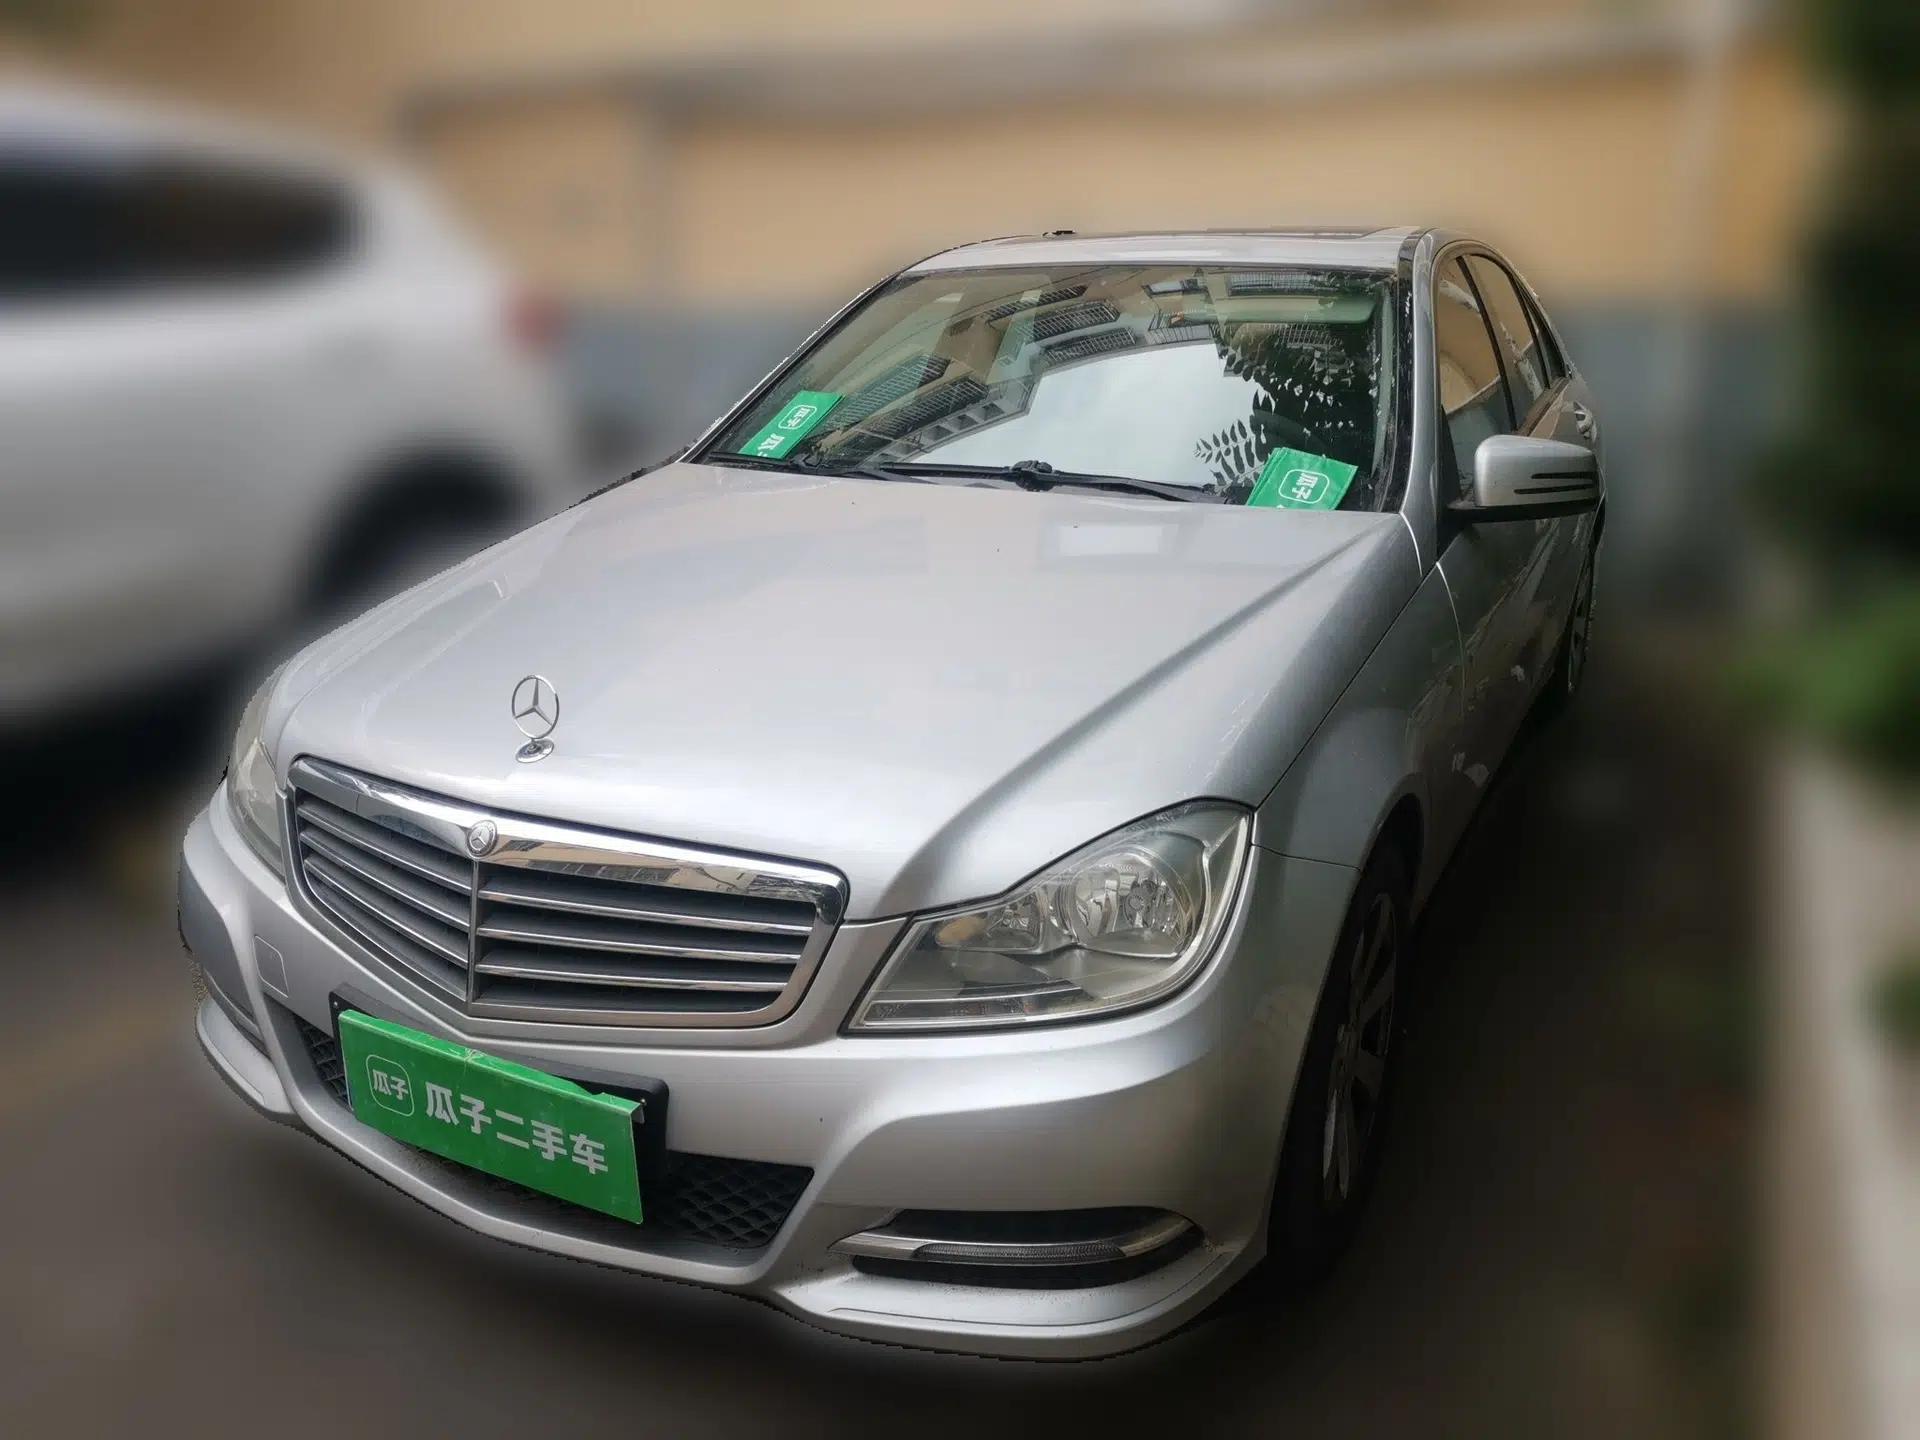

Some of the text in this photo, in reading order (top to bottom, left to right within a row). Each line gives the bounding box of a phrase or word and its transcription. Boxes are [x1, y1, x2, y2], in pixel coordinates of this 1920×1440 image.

[757, 433, 785, 457] 瓜
[1291, 472, 1318, 500] 瓜子
[372, 1068, 409, 1101] 瓜子
[425, 1081, 609, 1175] 瓜子二手车
